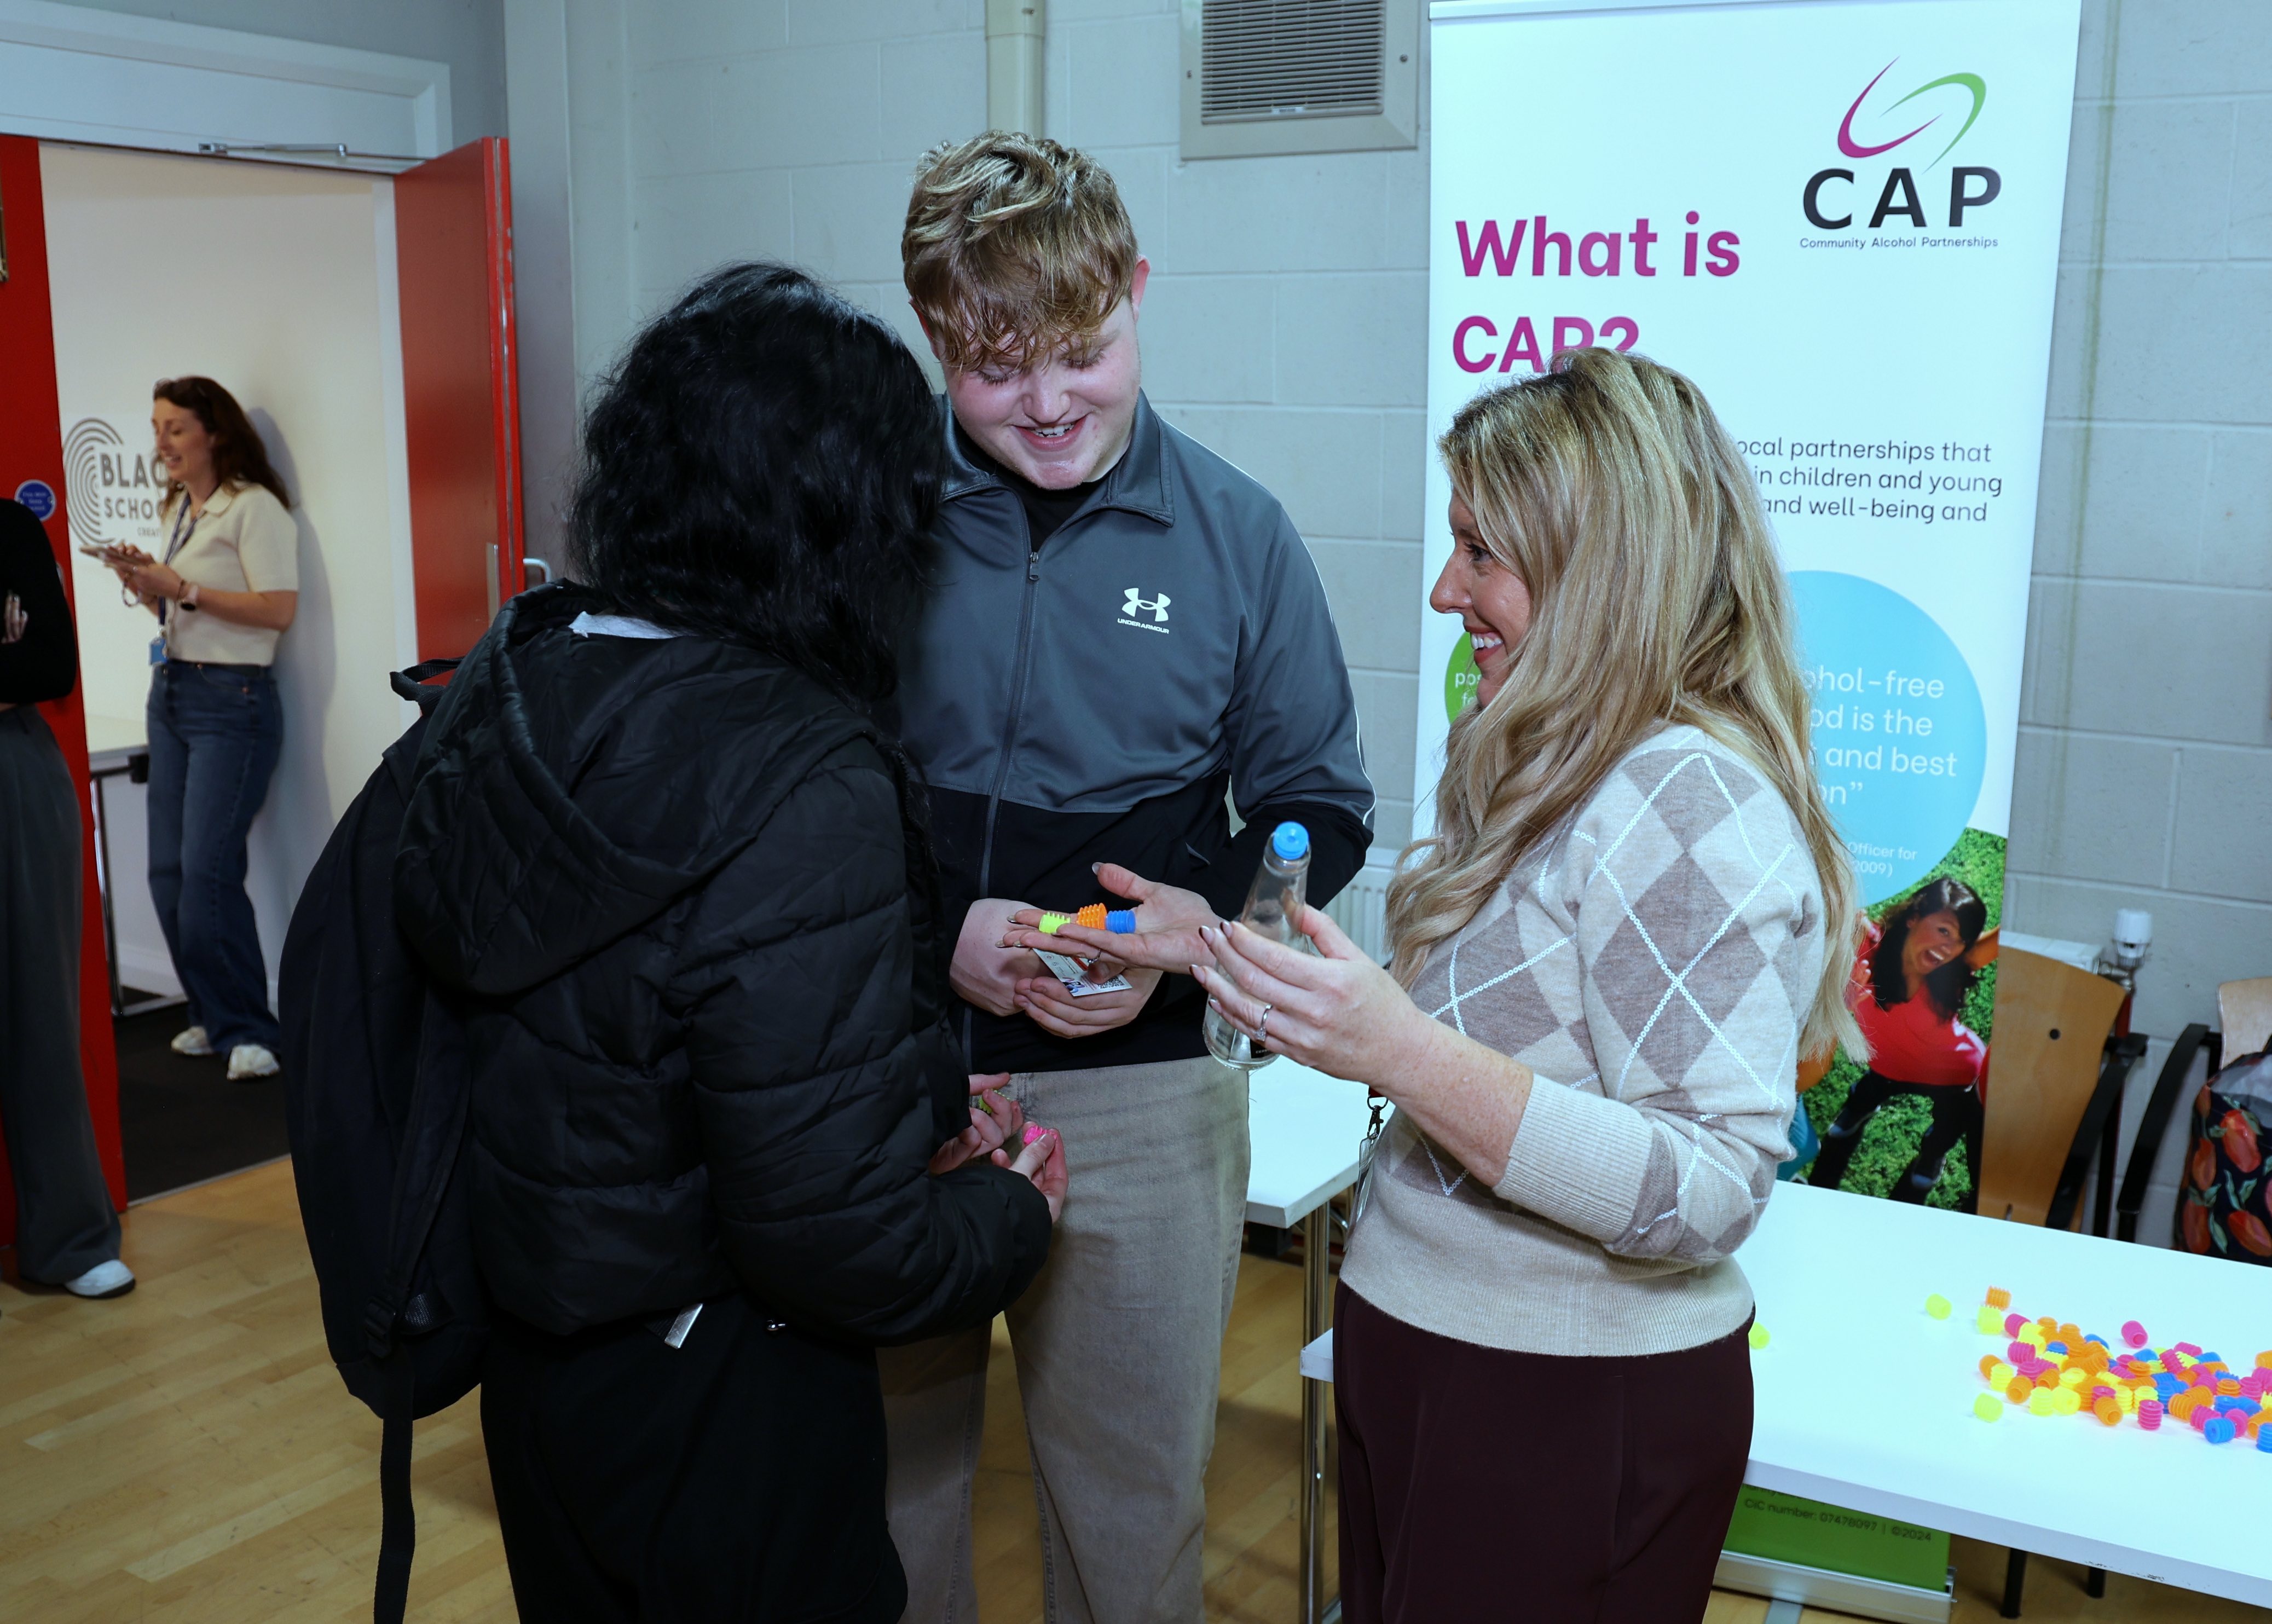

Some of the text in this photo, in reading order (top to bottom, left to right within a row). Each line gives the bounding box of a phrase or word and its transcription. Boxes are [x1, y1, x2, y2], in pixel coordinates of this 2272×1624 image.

[1802, 166, 2002, 229] CAP
[1455, 210, 1741, 277] What is
[1800, 236, 1999, 250] Community Alcohol Partnerships
[1790, 438, 1935, 465] partnerships
[1942, 441, 1992, 463] that
[1754, 465, 2003, 498] in children and young
[1808, 496, 1935, 524] well-being
[1941, 501, 1988, 522] and
[1853, 706, 1875, 732] is
[1882, 708, 1933, 736] the
[1825, 744, 1883, 771] and
[1891, 746, 1958, 777] best
[1847, 841, 1918, 860] Officer for
[1767, 1502, 1817, 1521] number:
